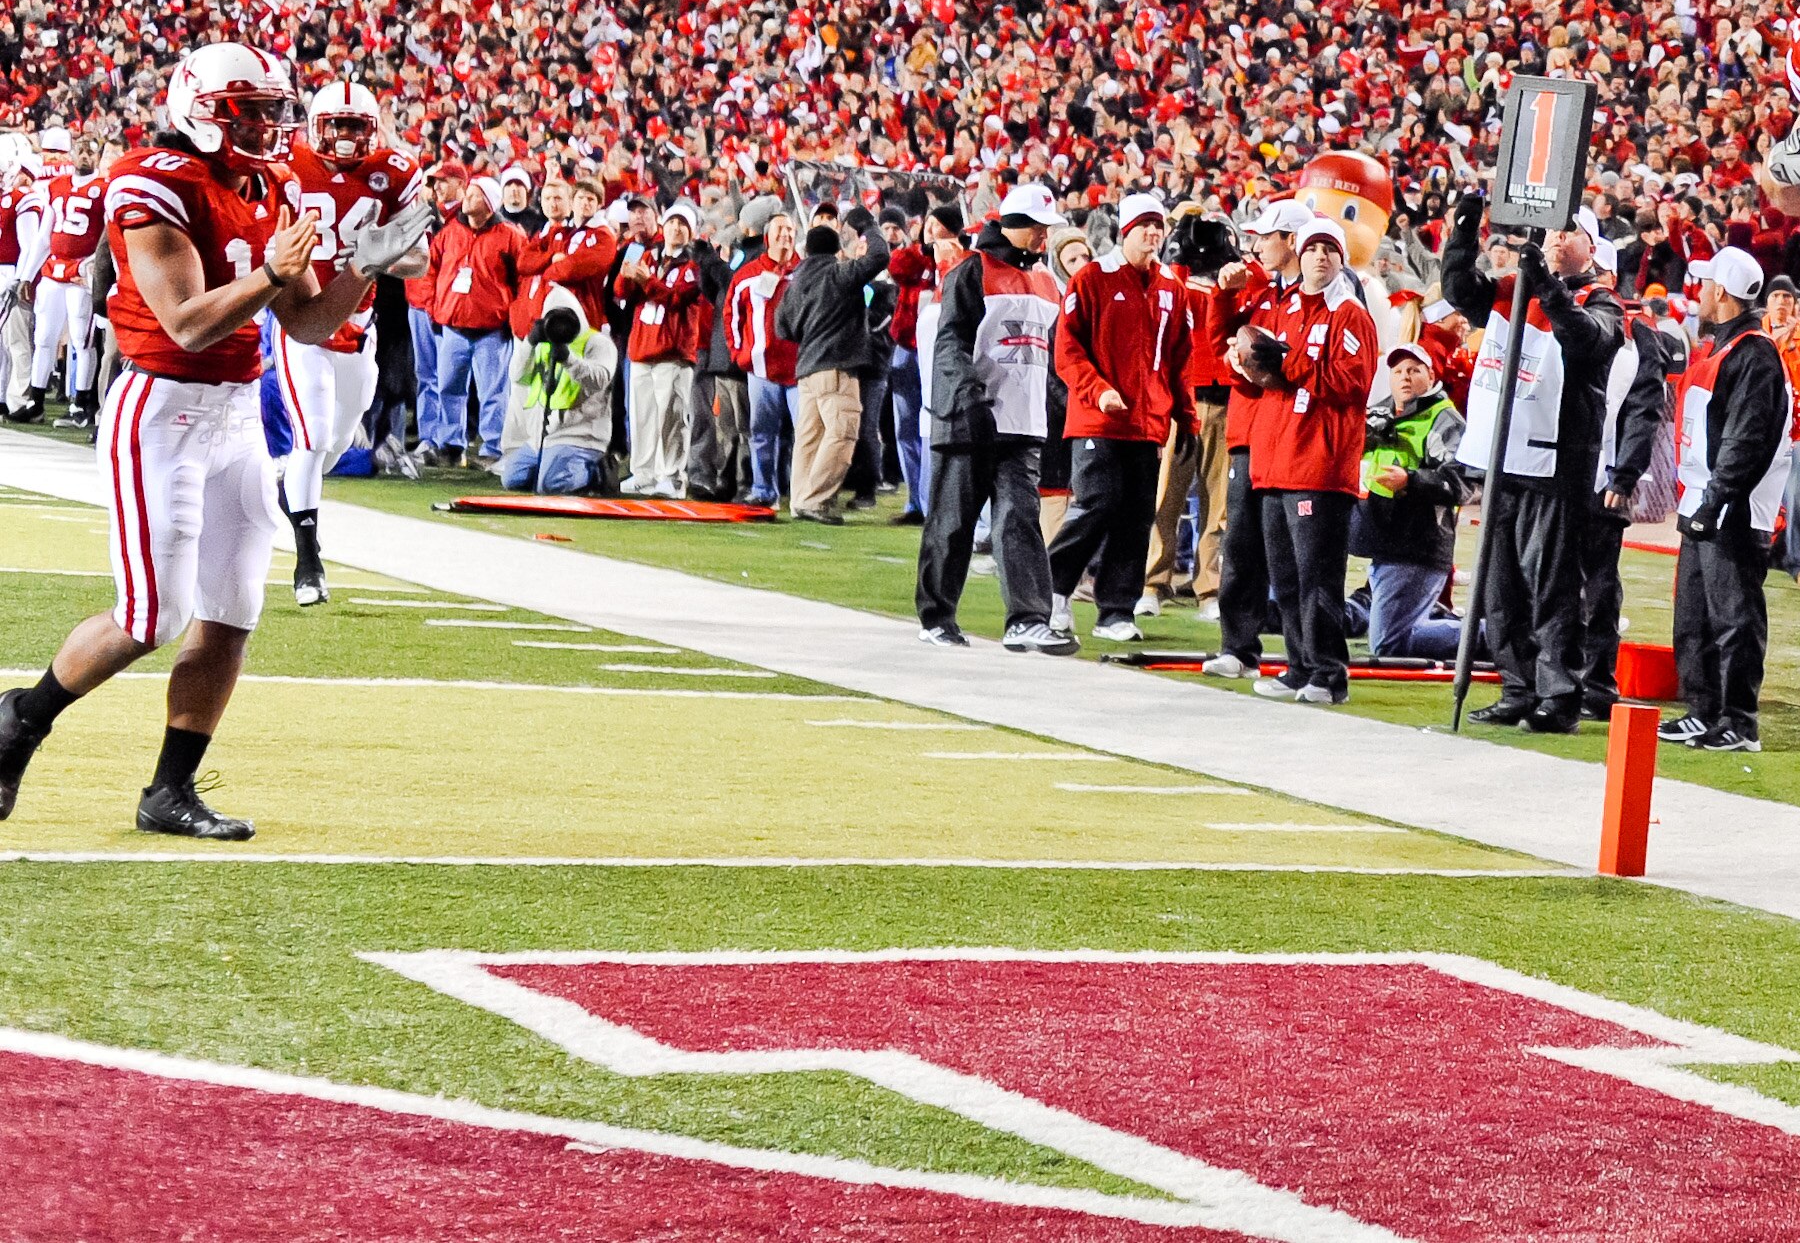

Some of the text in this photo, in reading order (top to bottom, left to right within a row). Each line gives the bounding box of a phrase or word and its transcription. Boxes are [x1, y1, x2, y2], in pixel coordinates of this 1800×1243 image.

[1525, 90, 1558, 186] 1
[140, 152, 192, 171] 10
[1333, 179, 1360, 194] RED
[51, 196, 93, 236] 15
